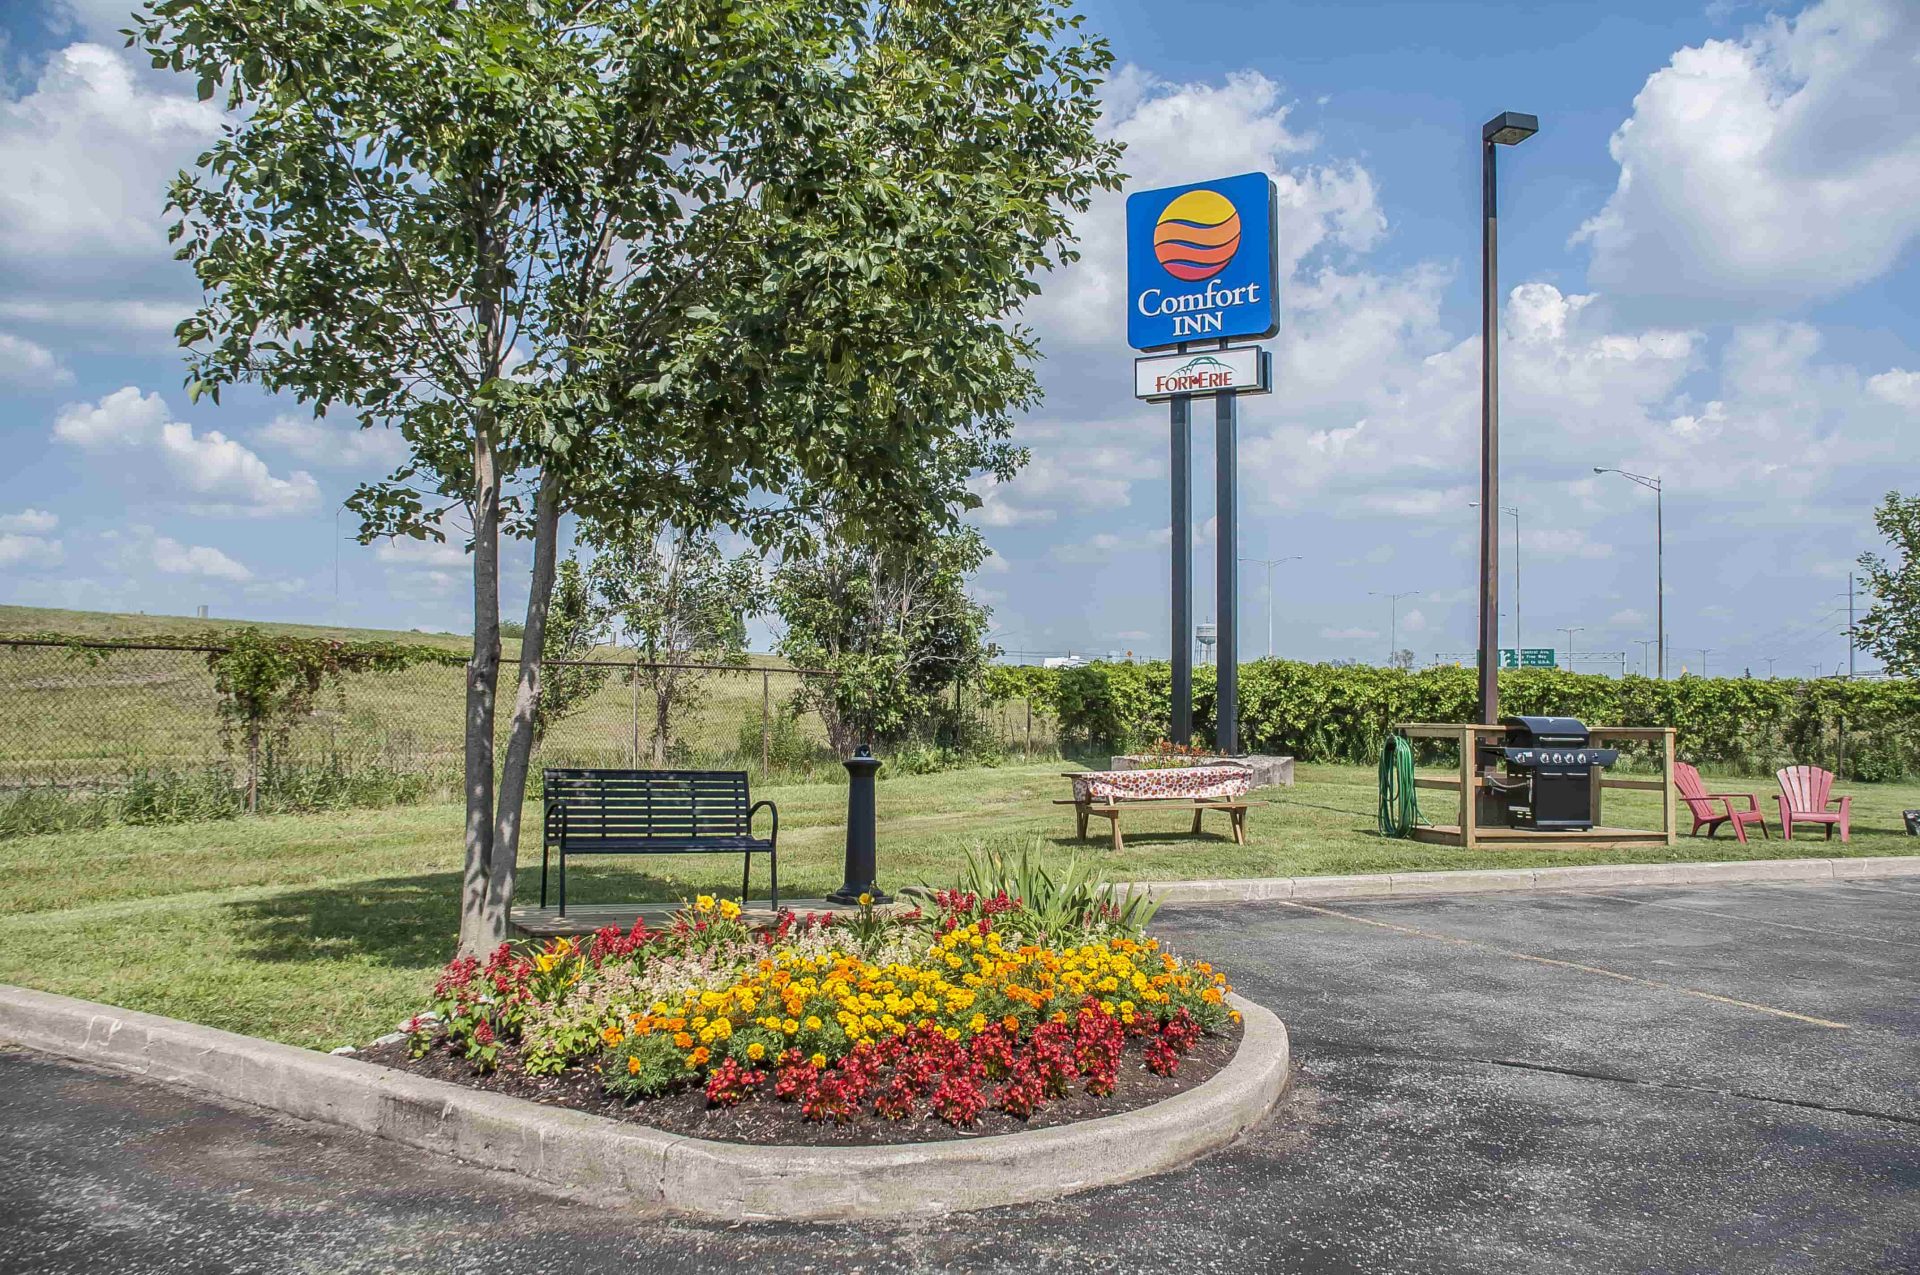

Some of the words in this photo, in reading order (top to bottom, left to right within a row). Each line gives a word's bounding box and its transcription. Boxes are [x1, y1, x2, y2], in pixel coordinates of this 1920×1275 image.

[1138, 279, 1260, 316] Comfort
[1172, 311, 1223, 336] INN
[1155, 375, 1194, 392] FORT
[1198, 371, 1232, 389] ERIE
